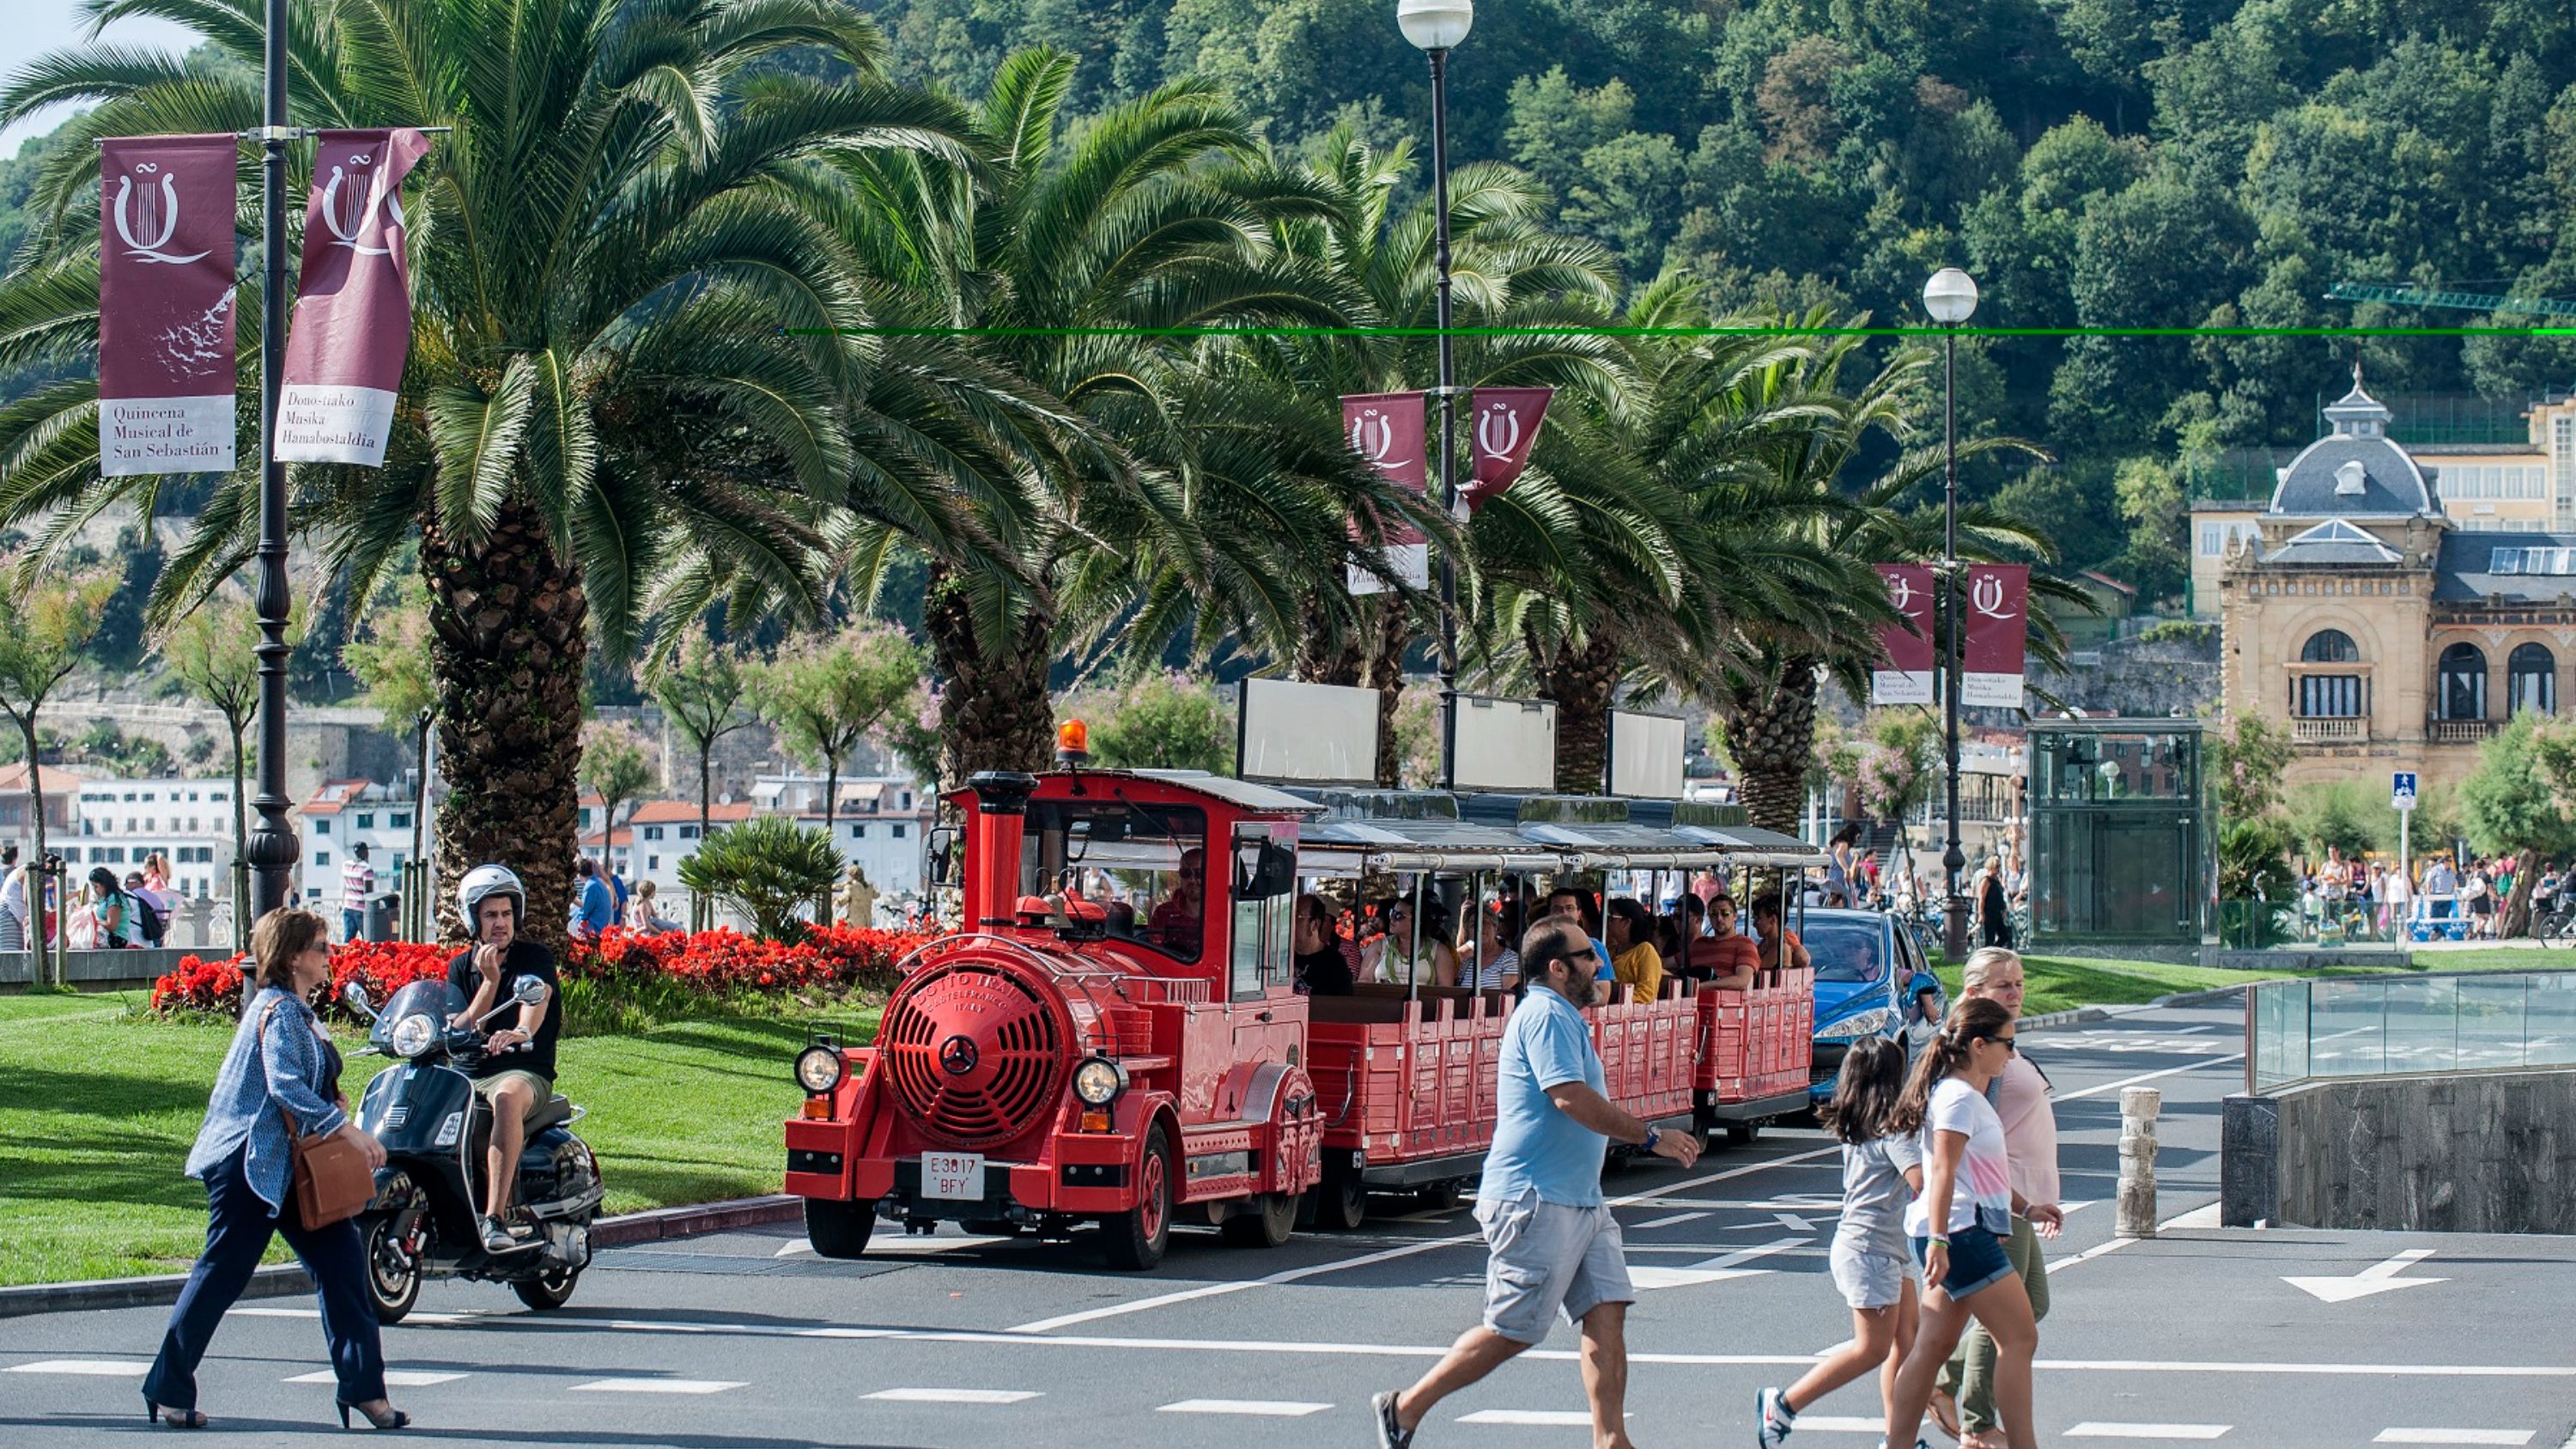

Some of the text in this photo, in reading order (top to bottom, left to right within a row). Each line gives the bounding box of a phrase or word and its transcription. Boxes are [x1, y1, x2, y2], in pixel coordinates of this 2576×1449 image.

[113, 405, 185, 423] Quincena
[284, 411, 325, 425] Musika
[113, 423, 193, 439] Musical de
[283, 429, 375, 447] Hamabostaldia
[113, 441, 219, 459] San Sebastián
[917, 974, 970, 1006] DOTTO
[954, 1002, 986, 1014] ITALY
[931, 1157, 975, 1174] E3817
[941, 1178, 965, 1194] BFY
